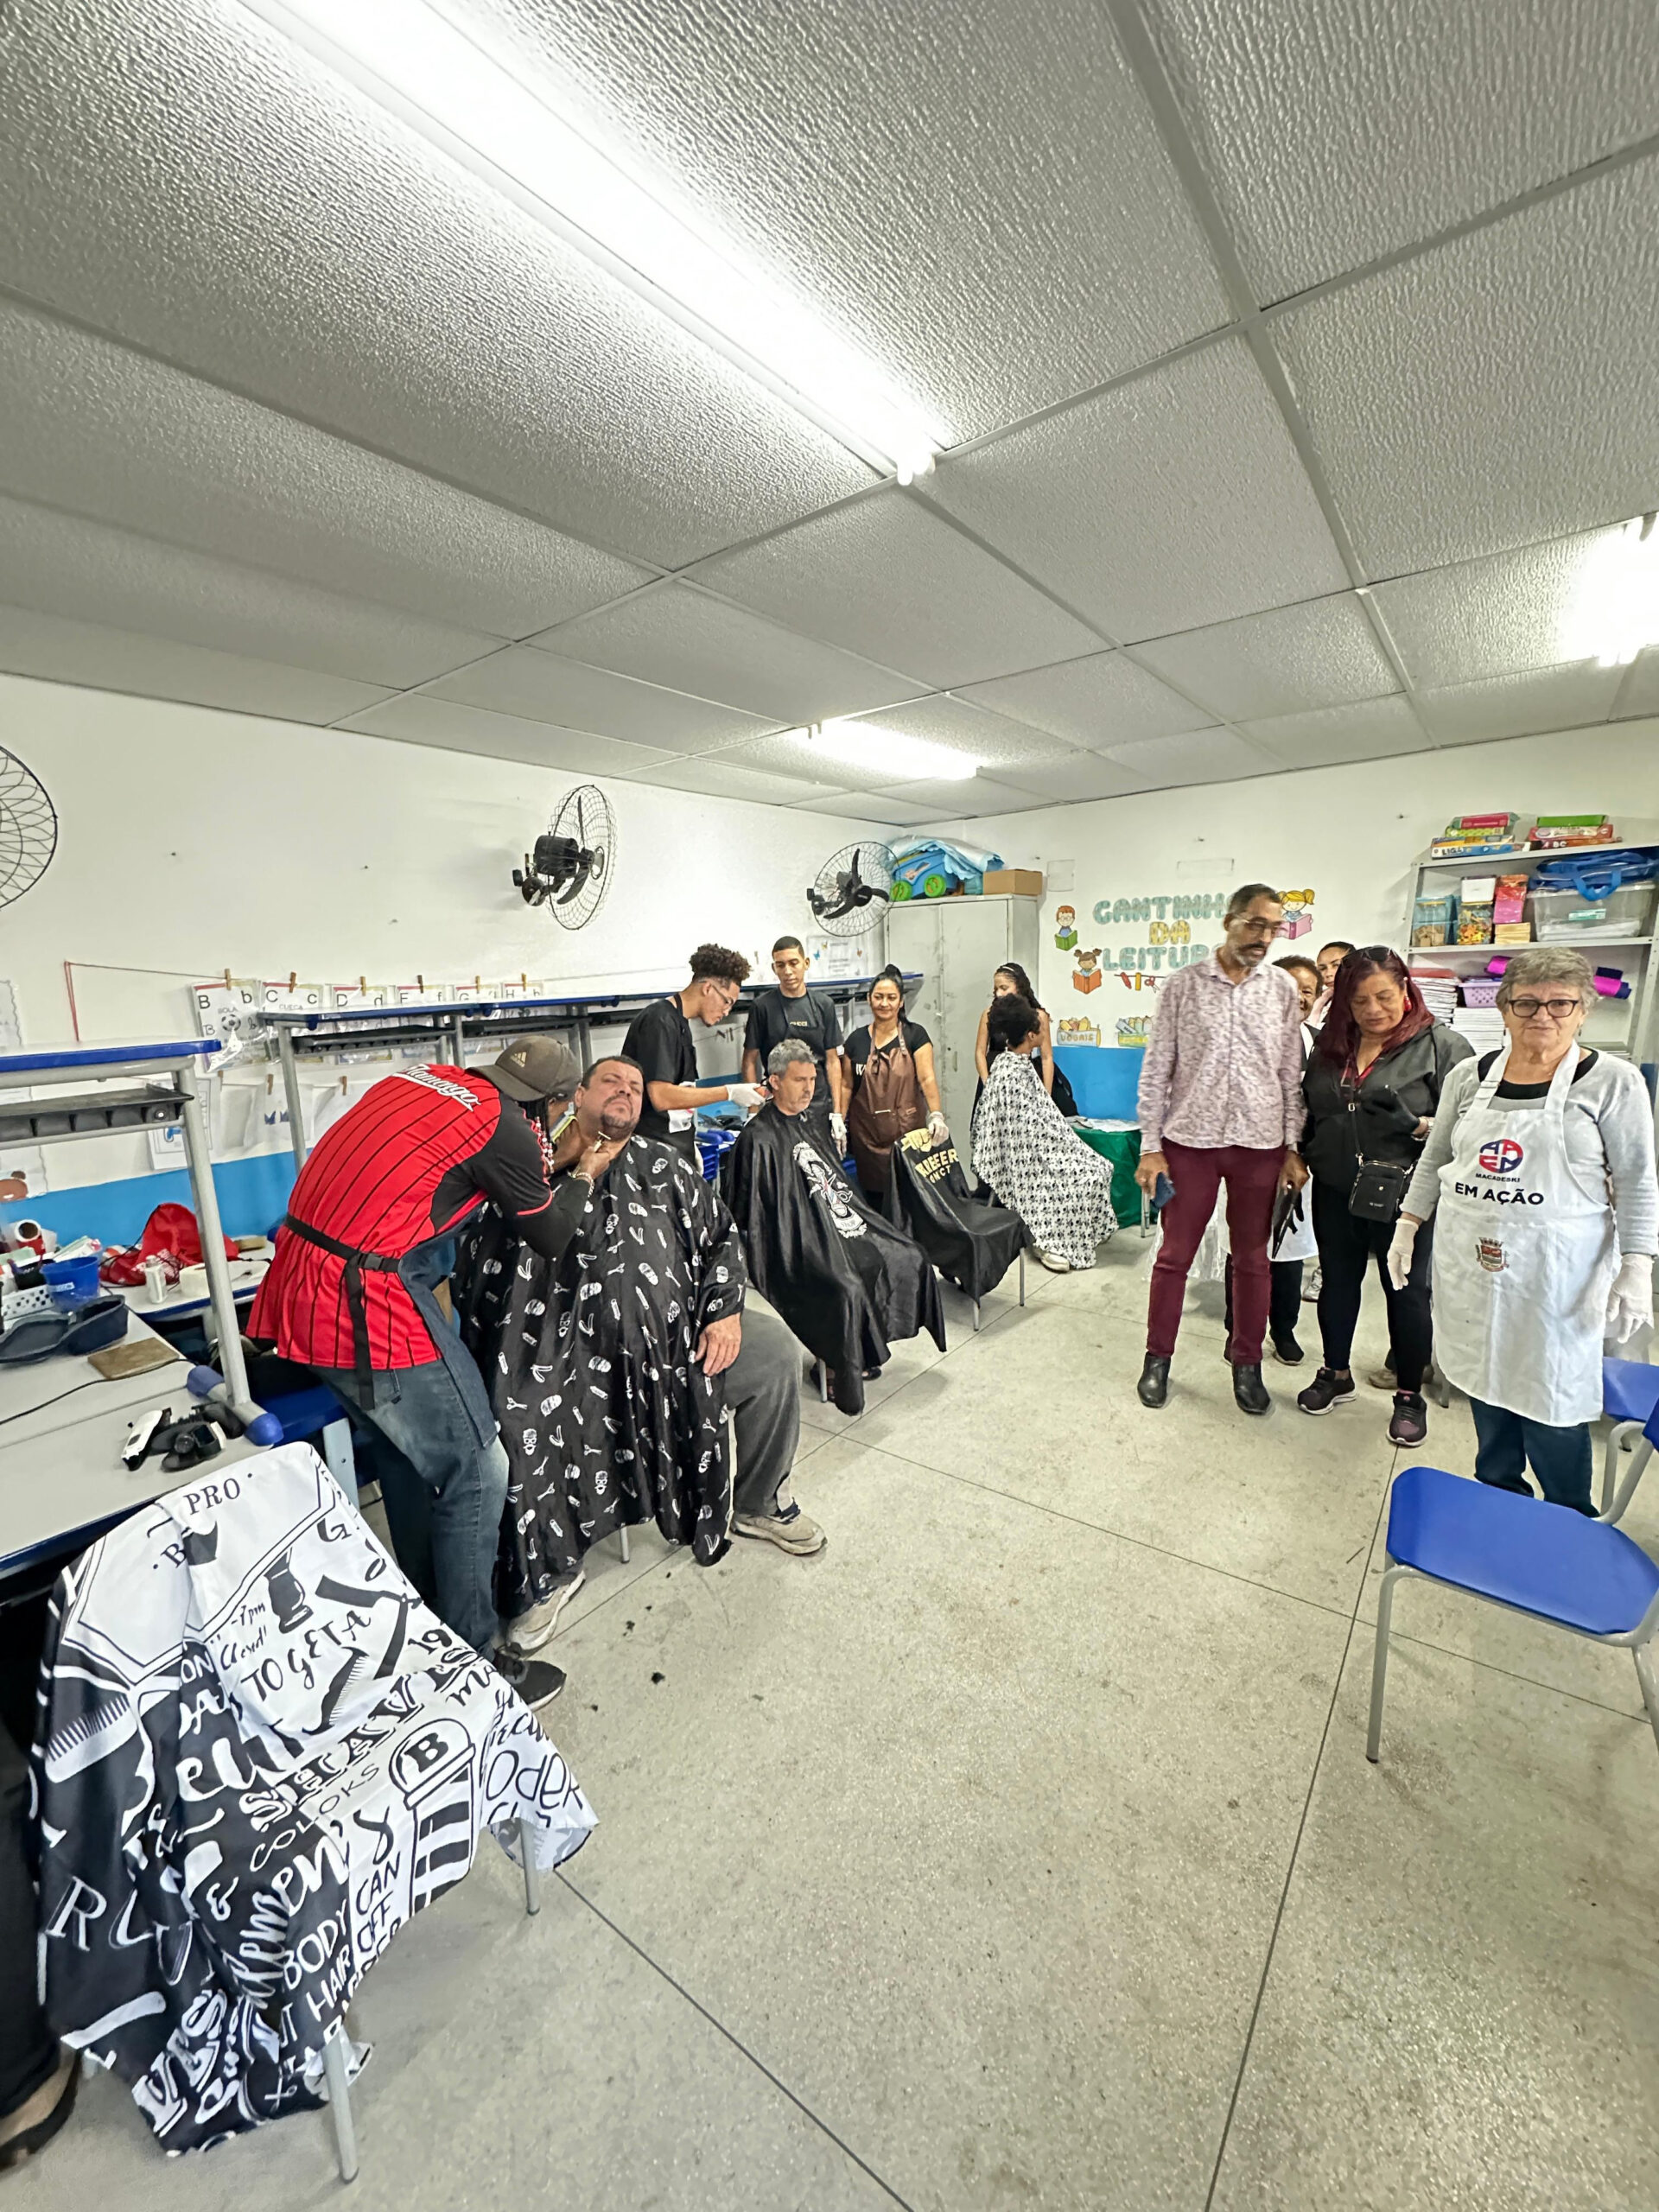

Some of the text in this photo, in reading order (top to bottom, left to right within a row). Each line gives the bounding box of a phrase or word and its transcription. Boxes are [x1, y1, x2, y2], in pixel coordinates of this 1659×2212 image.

[1093, 893, 1230, 925] CANTINH
[1149, 919, 1191, 945] DA
[1103, 944, 1222, 970] LEITUR
[1455, 1182, 1544, 1205] EM AÇÃO
[183, 1478, 241, 1516] PRO
